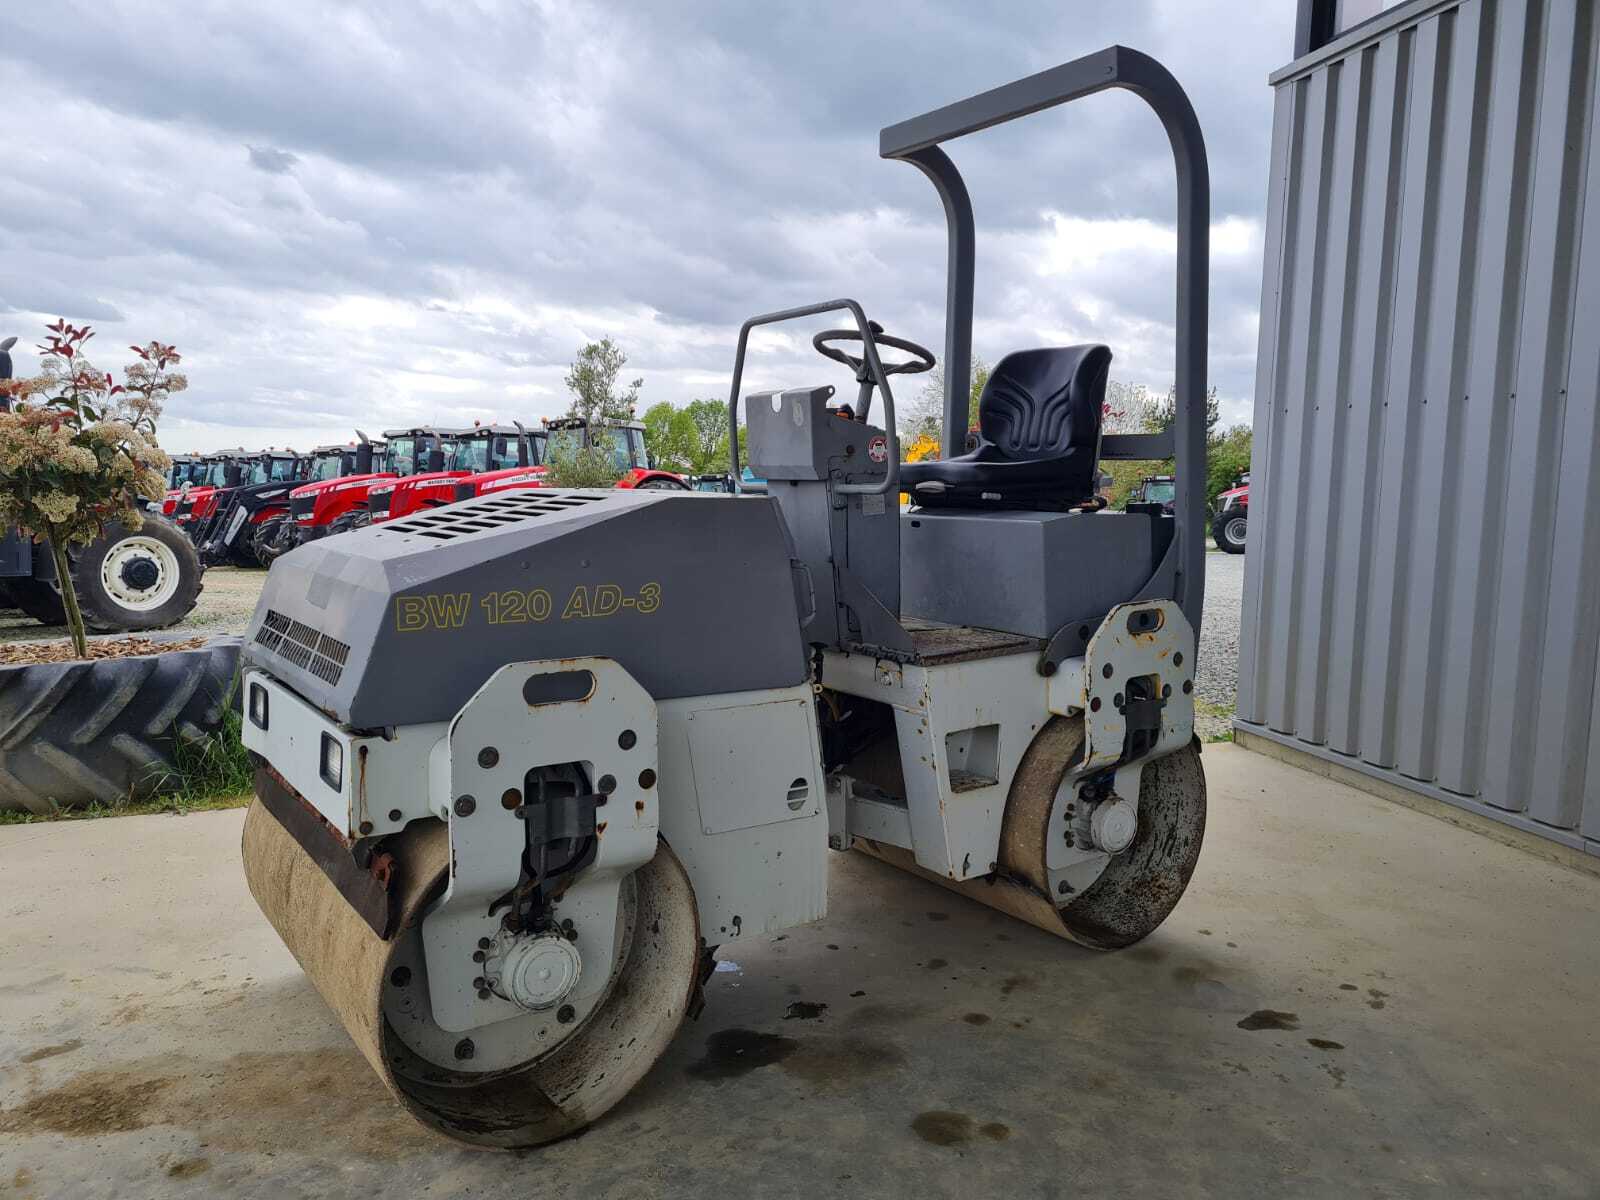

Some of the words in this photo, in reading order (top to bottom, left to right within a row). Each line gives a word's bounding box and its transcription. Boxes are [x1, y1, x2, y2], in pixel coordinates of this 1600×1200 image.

[396, 593, 471, 632] BW
[480, 589, 552, 625] 120
[561, 583, 661, 619] AD-3
